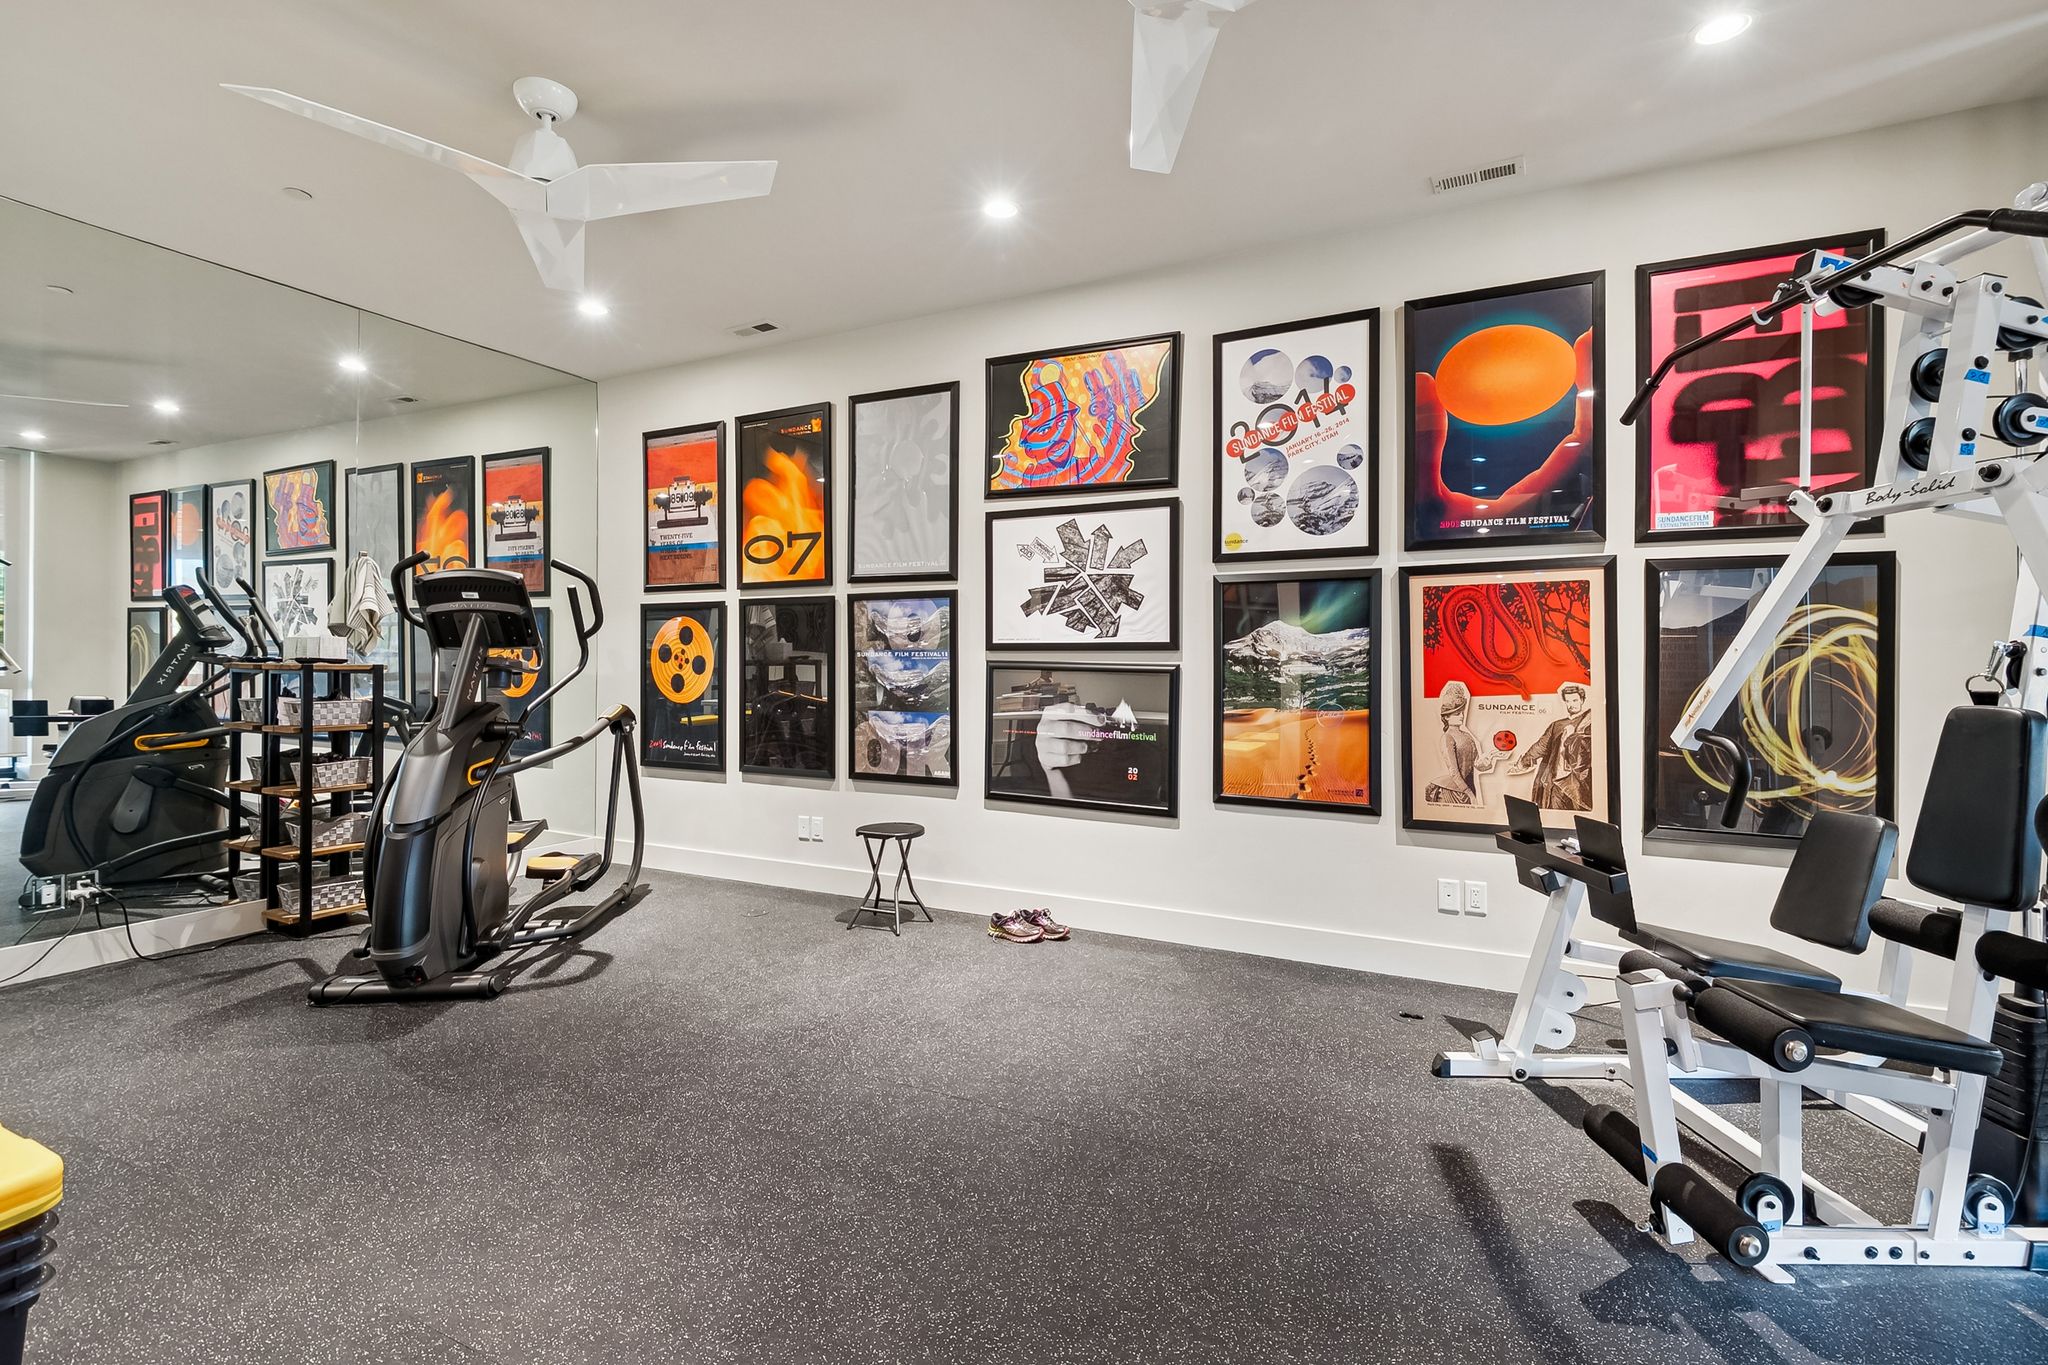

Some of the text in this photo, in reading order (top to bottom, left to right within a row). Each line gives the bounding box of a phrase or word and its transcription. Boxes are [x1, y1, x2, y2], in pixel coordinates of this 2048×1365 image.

[1231, 389, 1350, 453] SUNDANCE FILM FESTIVAL
[1285, 433, 1314, 453] JANUARY
[1335, 417, 1350, 430] 2014
[1287, 447, 1304, 459] PARK
[1321, 431, 1339, 444] UTAH
[1865, 476, 1956, 505] Body-Solid
[1460, 518, 1503, 527] SUNDANCE
[1505, 517, 1527, 525] FILM
[1528, 515, 1570, 524] FESTIVAL
[744, 531, 822, 575] 07
[1478, 703, 1535, 711] SUNDANCE
[1128, 773, 1138, 781] 02
